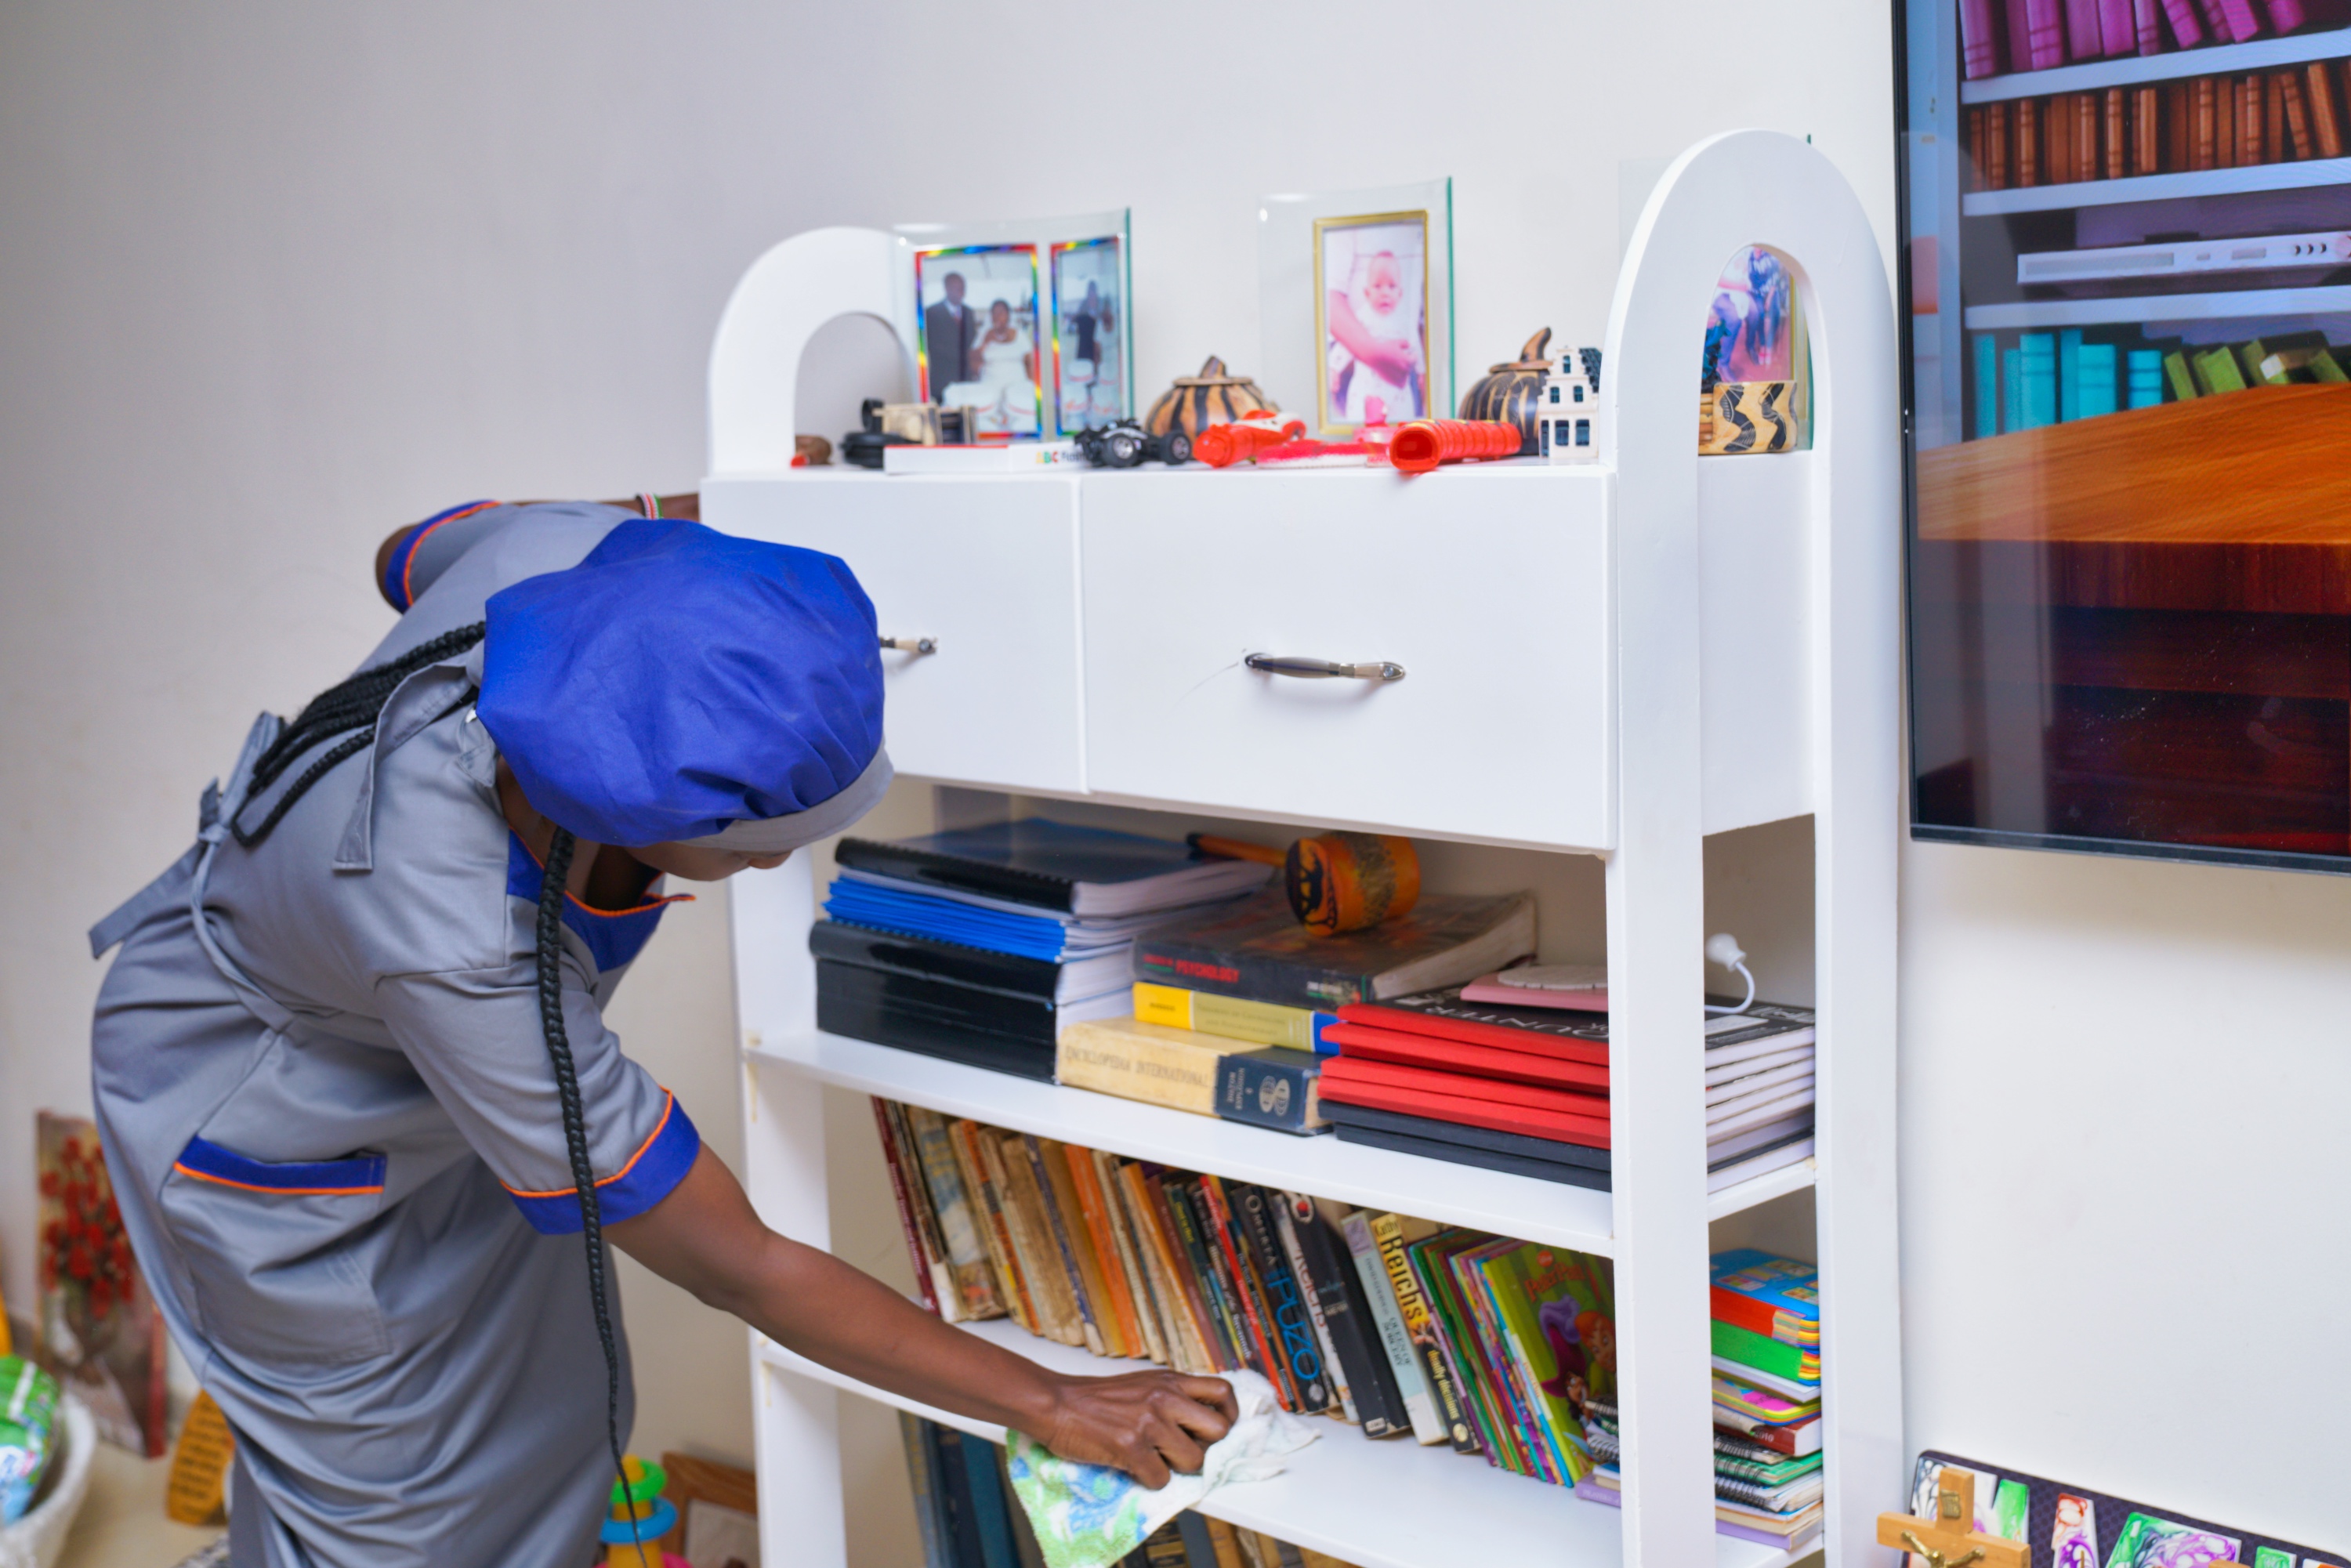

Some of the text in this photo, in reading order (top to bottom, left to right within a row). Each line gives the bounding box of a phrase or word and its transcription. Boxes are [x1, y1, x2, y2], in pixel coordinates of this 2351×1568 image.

[1036, 451, 1058, 463] ABC
[1065, 1045, 1208, 1088] ENCYCLOPEDIA INTERNATIONAL
[1380, 1235, 1422, 1320] Reichs
[1523, 1270, 1558, 1304] Peter
[1266, 1276, 1320, 1380] PUZO
[1427, 1350, 1447, 1379] deadly
